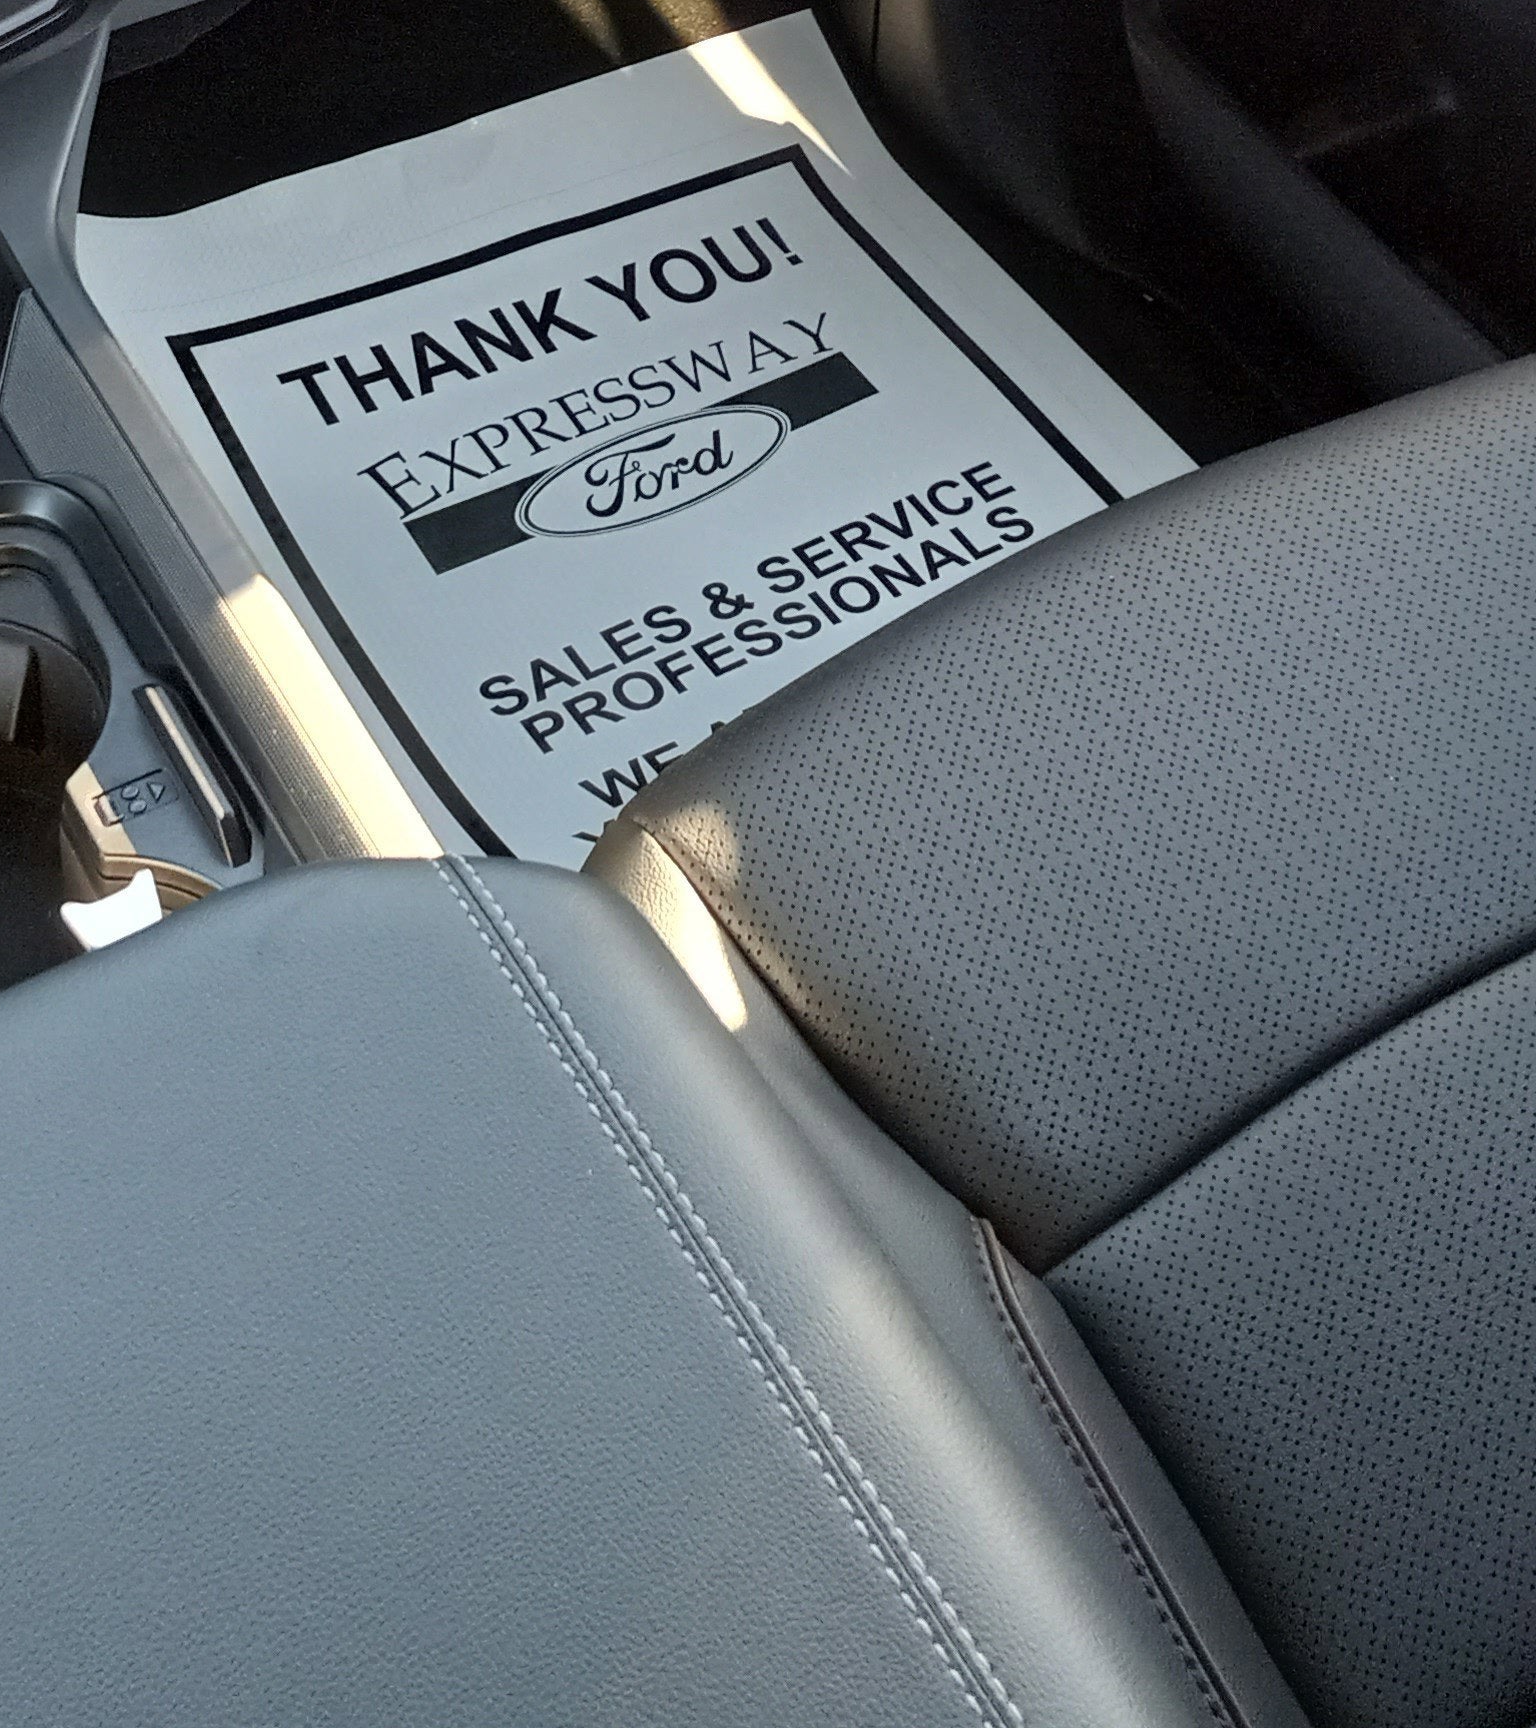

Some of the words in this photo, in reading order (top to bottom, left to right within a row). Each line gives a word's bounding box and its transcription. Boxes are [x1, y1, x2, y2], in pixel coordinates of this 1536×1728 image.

[277, 285, 597, 427] THANK
[585, 216, 806, 324] YOU!
[357, 311, 837, 520] EXPRESSWAY
[583, 428, 736, 524] Ford
[477, 602, 694, 718] SALES
[701, 580, 756, 620] &
[755, 460, 1018, 595] SERVICE
[517, 503, 1037, 755] PROFESSIONALS
